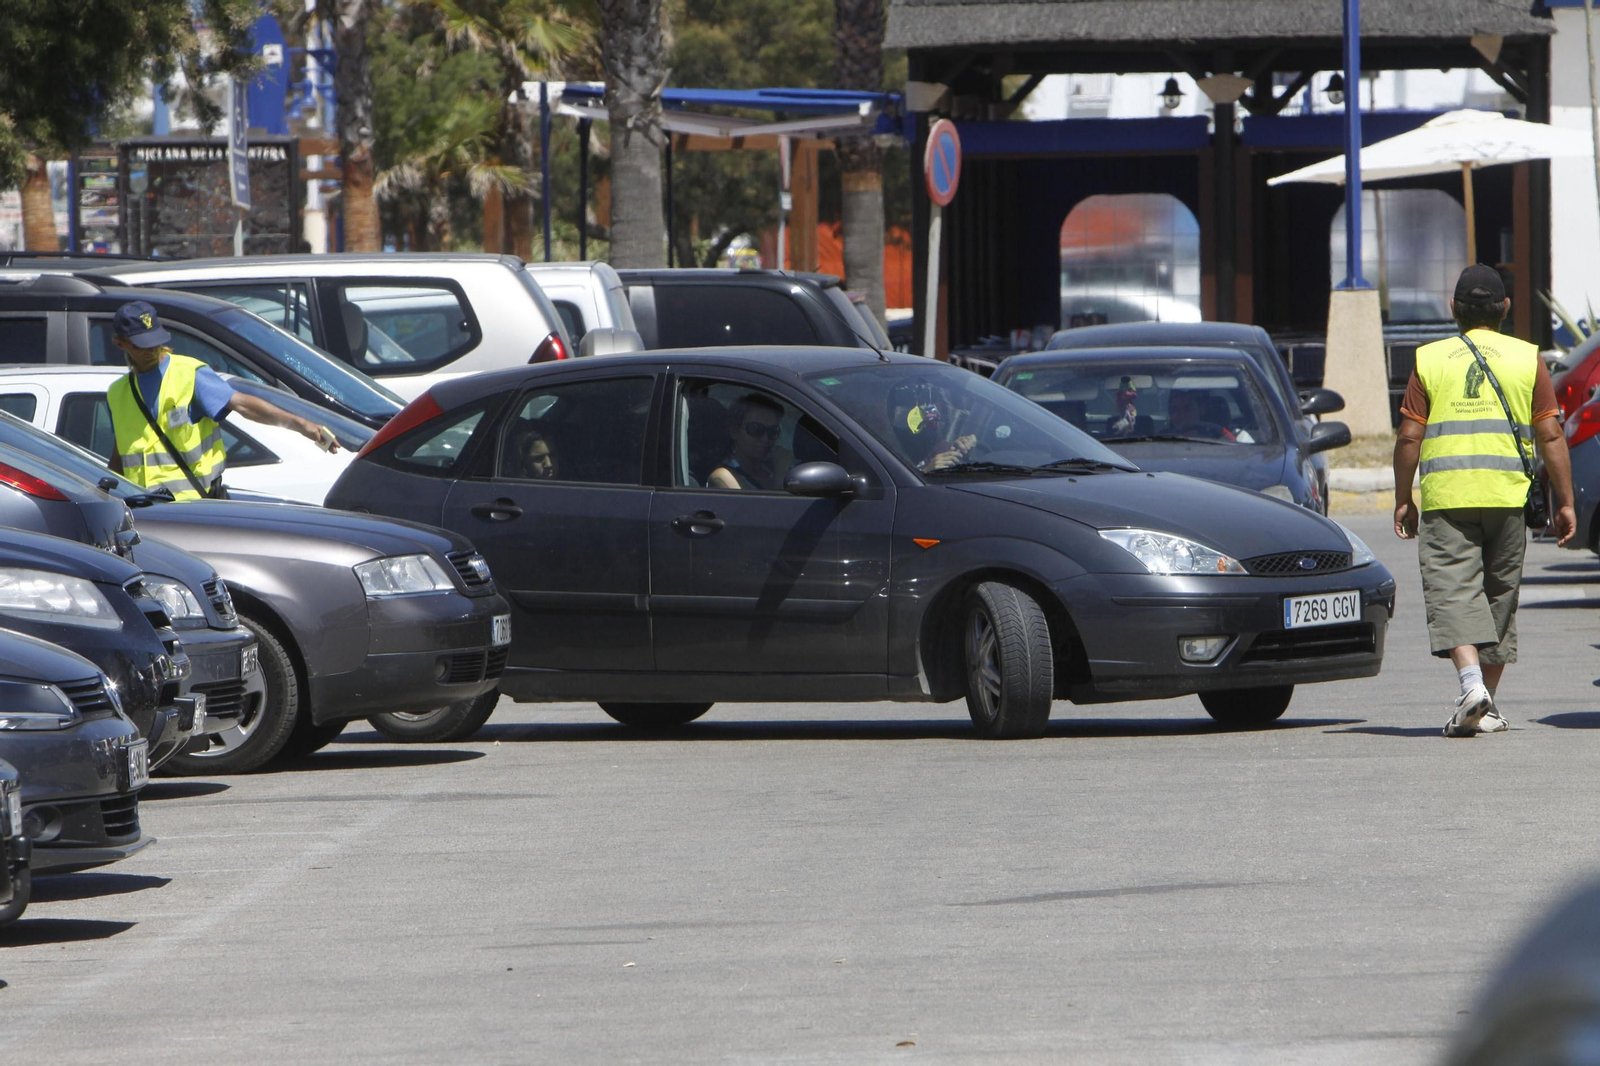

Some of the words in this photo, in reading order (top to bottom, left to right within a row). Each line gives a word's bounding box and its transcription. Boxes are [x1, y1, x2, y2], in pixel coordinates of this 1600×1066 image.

[129, 146, 188, 161] CHICLANA
[190, 146, 206, 161] DE
[208, 146, 223, 161] LA
[1294, 598, 1328, 623] 7269
[1333, 595, 1356, 619] CGV
